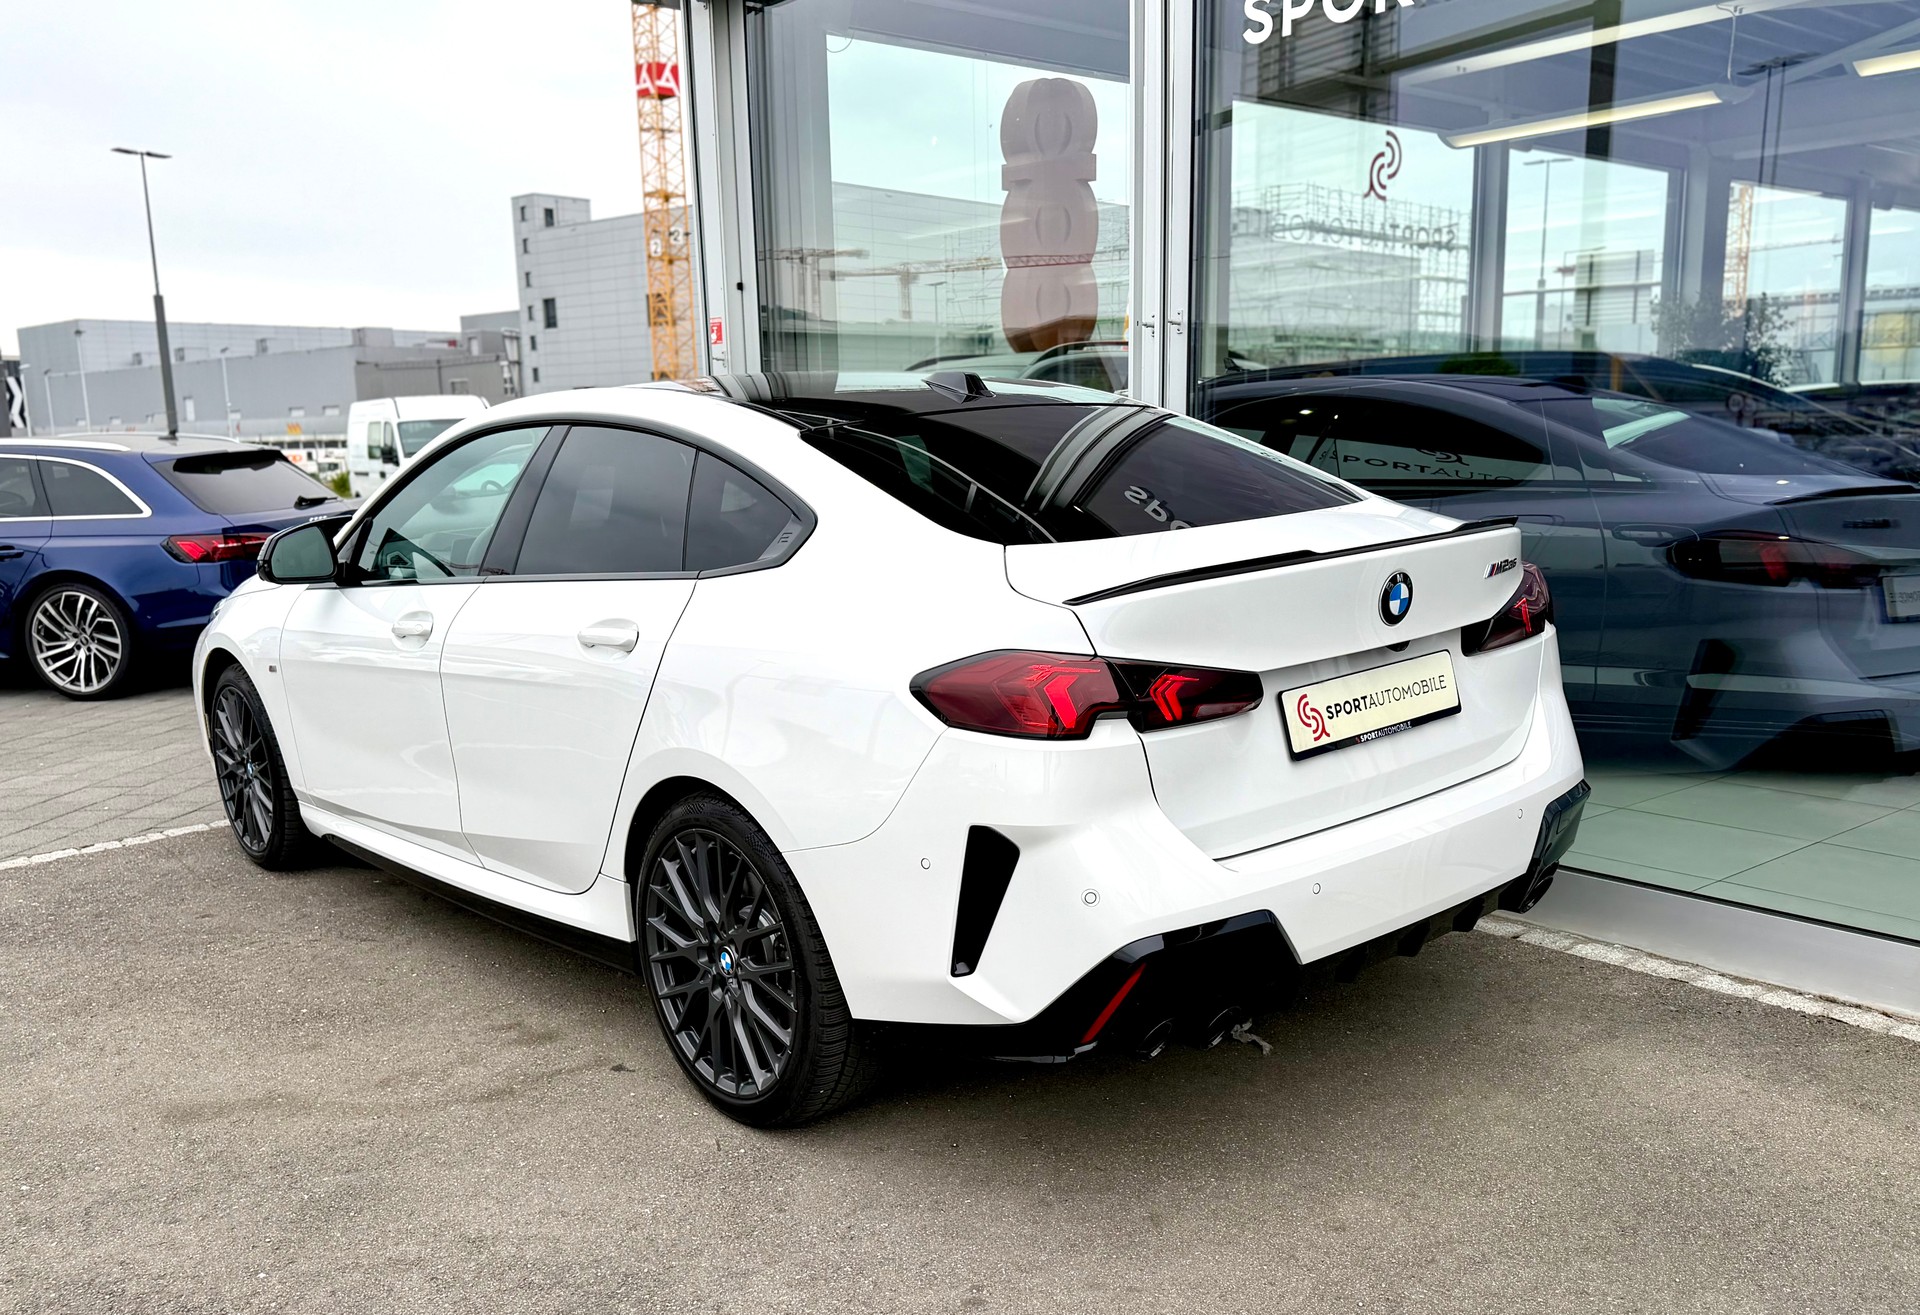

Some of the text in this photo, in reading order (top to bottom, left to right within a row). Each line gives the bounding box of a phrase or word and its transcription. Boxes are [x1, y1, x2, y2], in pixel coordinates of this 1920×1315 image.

[1242, 0, 1415, 45] SPO
[1325, 674, 1447, 720] SPORTAUTOMOBILE
[1360, 720, 1413, 743] SPORTAUTOMOBILE
